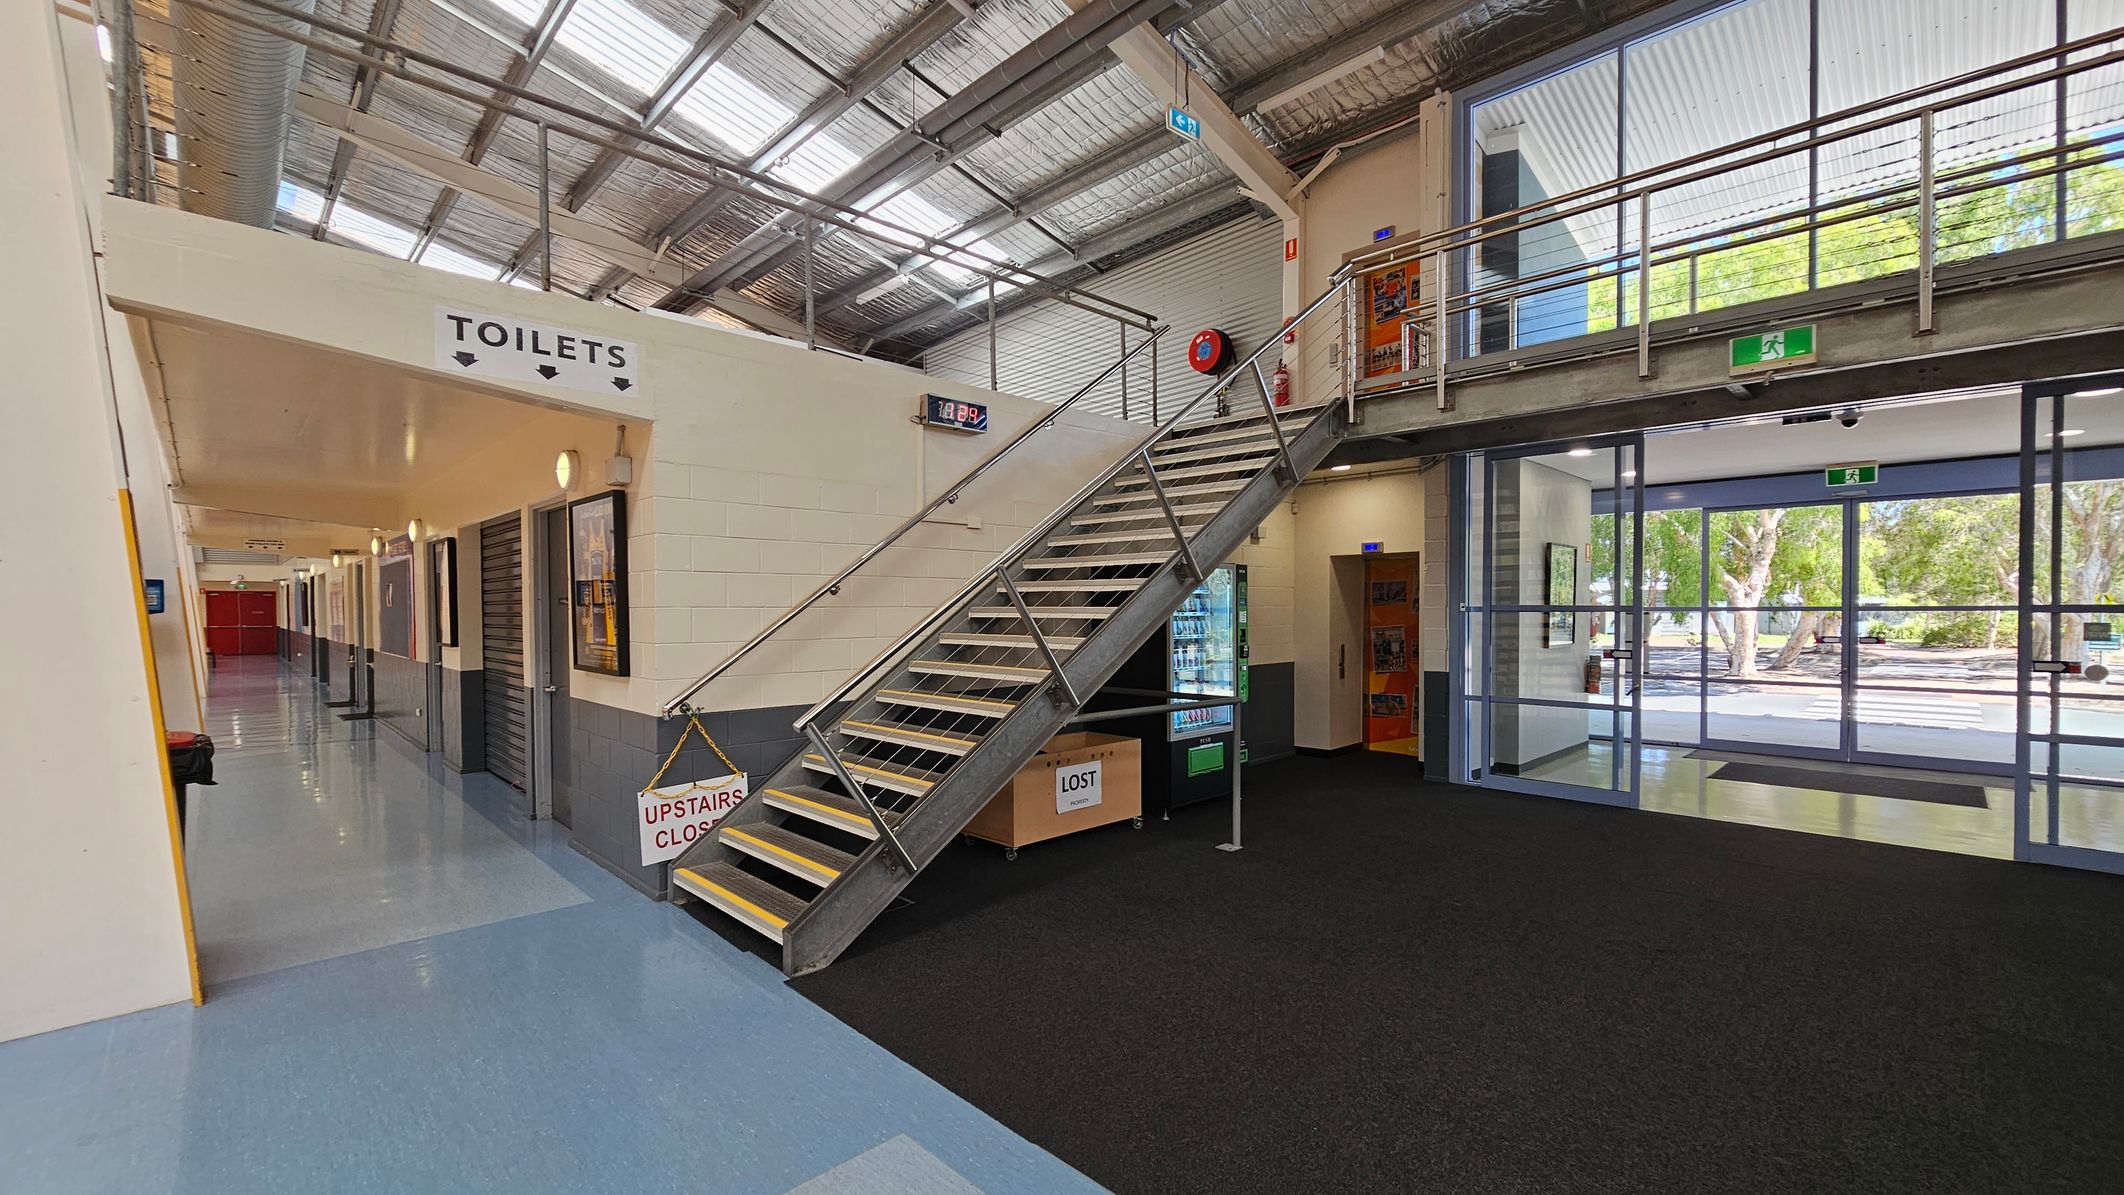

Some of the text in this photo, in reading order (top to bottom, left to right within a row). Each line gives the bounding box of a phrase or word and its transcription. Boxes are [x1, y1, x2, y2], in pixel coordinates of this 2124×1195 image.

[446, 314, 626, 369] TOILETS
[1061, 770, 1097, 793] LOST
[645, 789, 743, 825] UPSTAIRS
